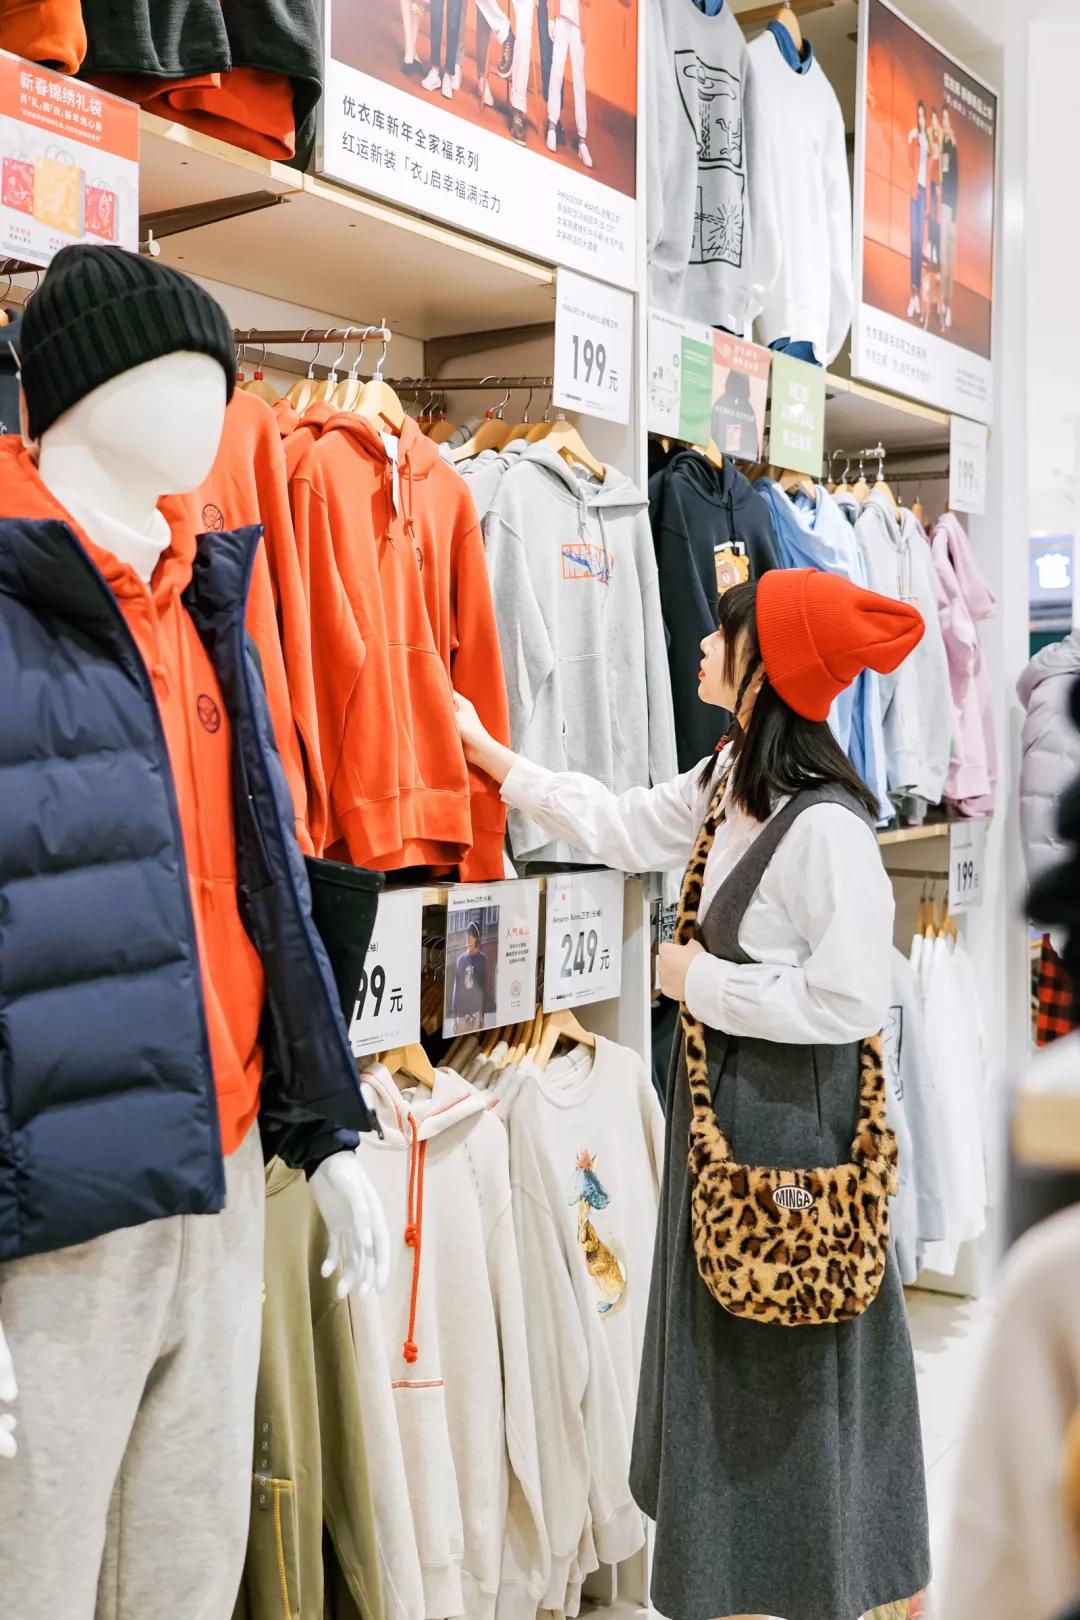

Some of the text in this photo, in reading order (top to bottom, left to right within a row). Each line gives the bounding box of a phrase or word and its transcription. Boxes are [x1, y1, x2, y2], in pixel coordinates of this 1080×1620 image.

[342, 95, 479, 172] 优衣库新年全家福系列
[775, 1189, 810, 1207] MINGA
